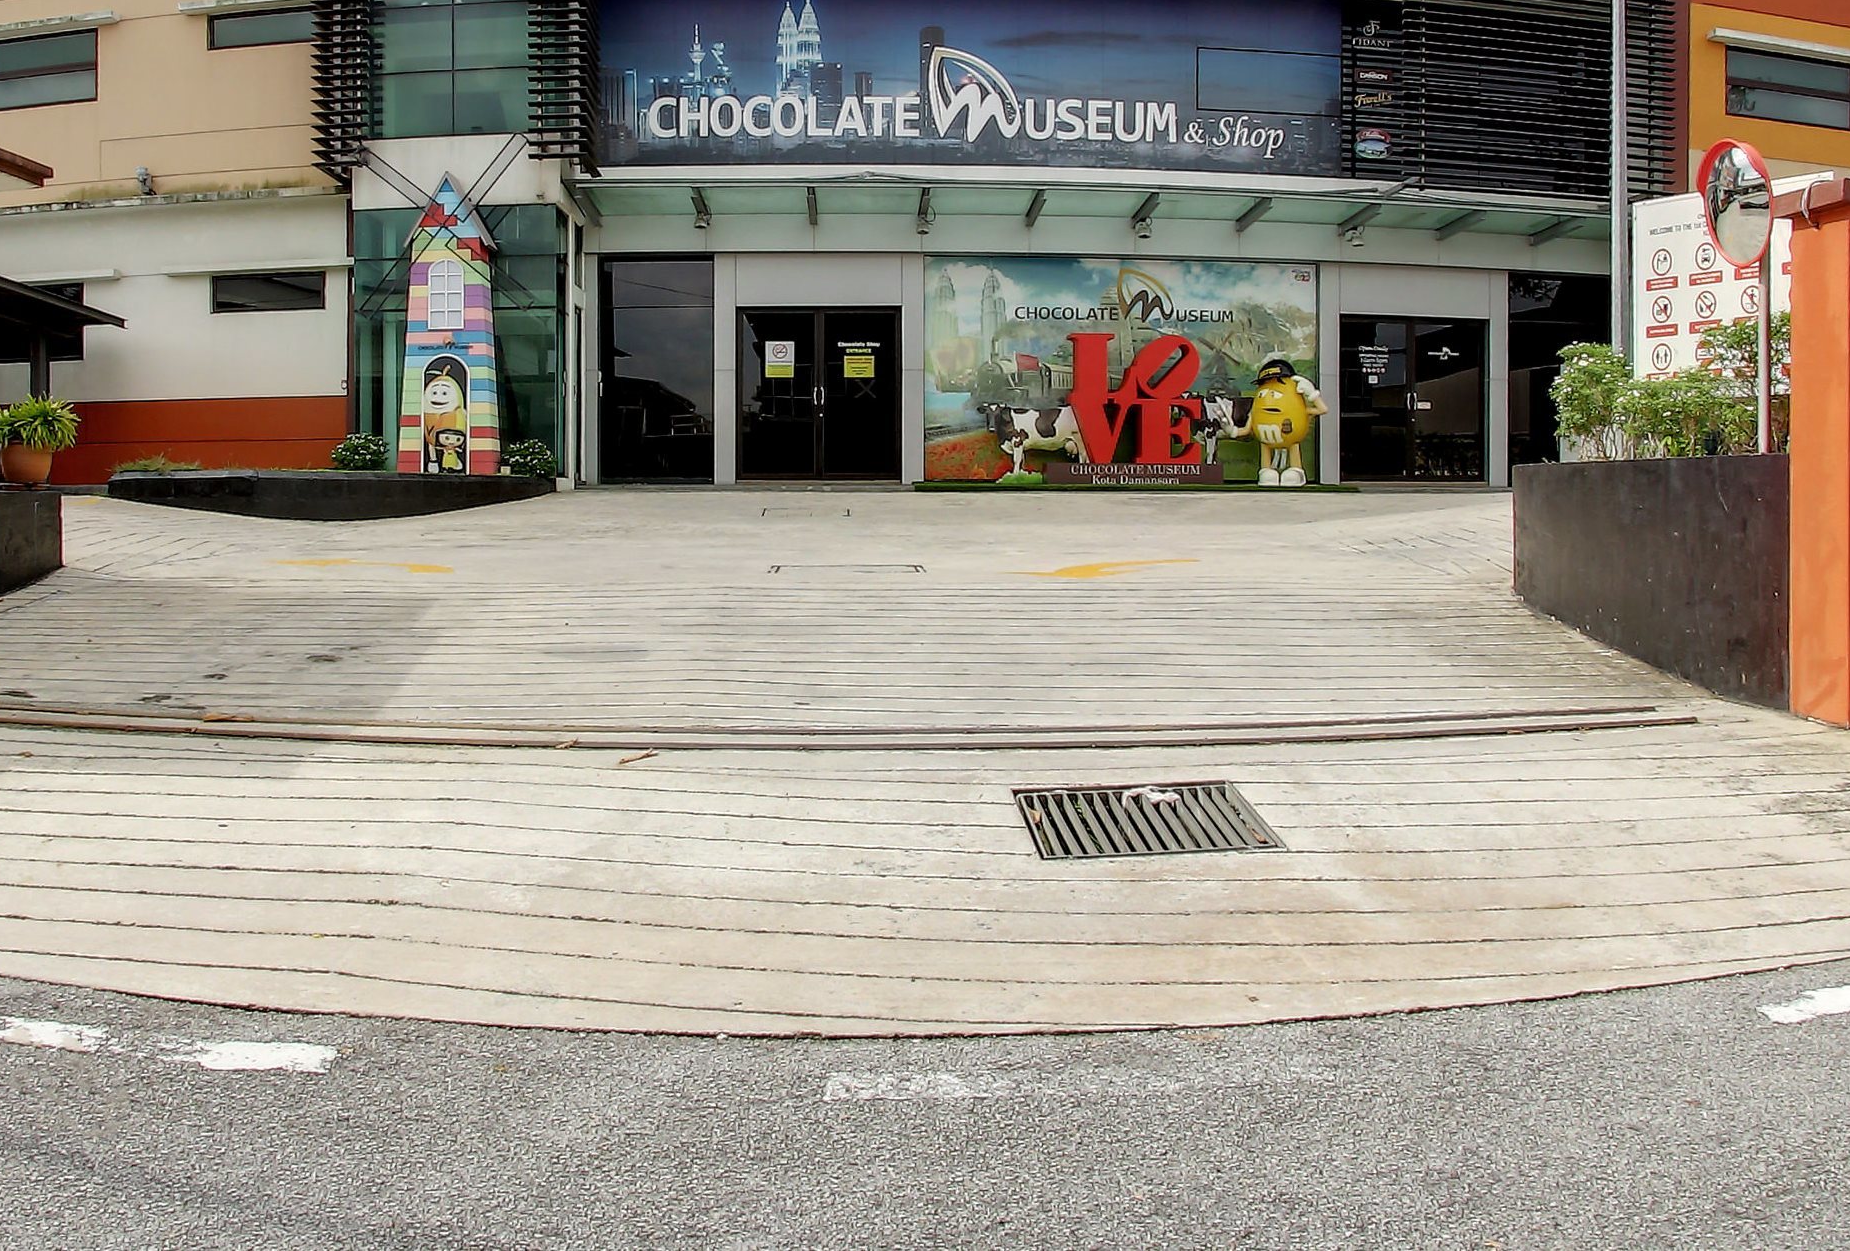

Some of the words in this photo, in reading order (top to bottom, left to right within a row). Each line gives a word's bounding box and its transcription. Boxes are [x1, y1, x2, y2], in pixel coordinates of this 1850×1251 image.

[648, 95, 921, 138] CHOCOLATE
[929, 46, 1178, 143] MUSEUM
[1183, 122, 1205, 144] &
[1211, 115, 1284, 158] Shop
[1014, 306, 1119, 321] CHOCOLATE
[1117, 268, 1234, 323] MUSEUM
[1070, 464, 1144, 475] CHOCOLATE
[1148, 464, 1201, 475] MUSEUM
[1092, 474, 1117, 485] Kota
[1119, 474, 1180, 485] Damansara
